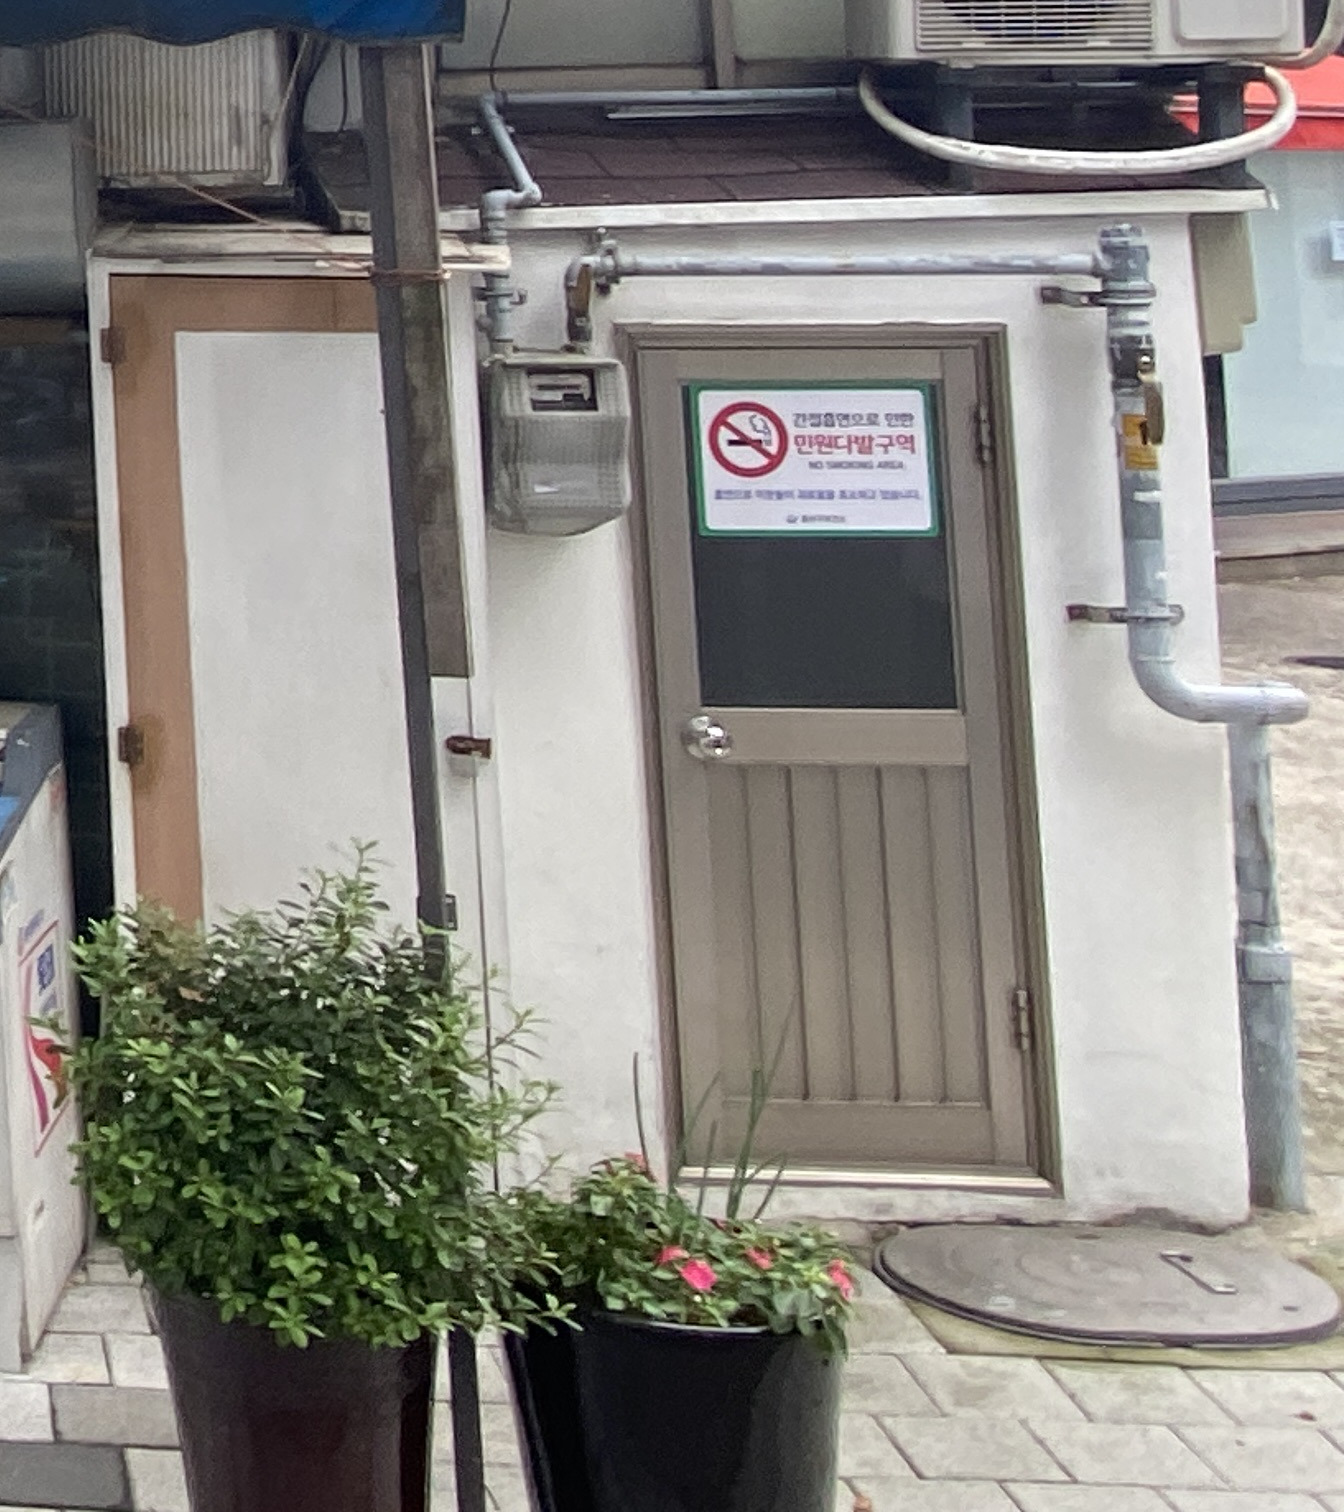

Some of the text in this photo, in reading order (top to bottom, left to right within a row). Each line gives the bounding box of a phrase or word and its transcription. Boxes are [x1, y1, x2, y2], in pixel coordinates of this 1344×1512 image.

[793, 434, 916, 456] 민원다발구역
[808, 460, 905, 469] NO SMOKING AREA
